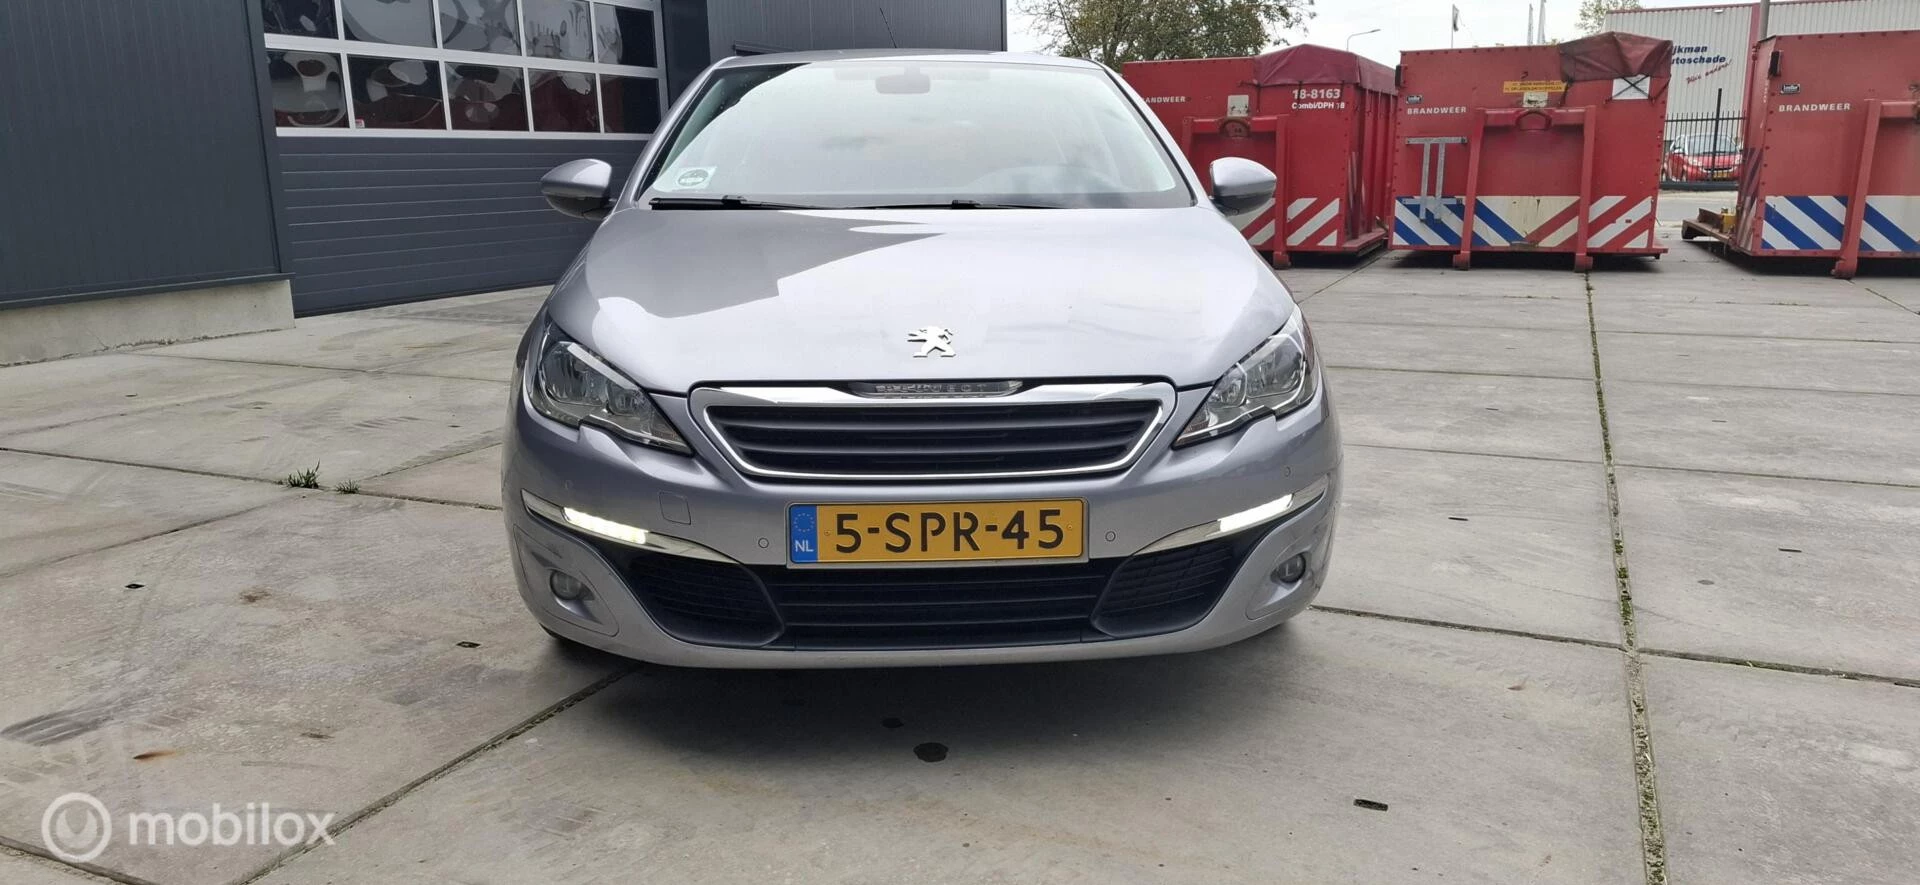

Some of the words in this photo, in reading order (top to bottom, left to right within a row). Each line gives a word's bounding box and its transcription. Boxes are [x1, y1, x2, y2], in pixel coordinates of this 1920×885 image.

[1671, 55, 1726, 65] toschade
[1292, 88, 1341, 99] 18-8163
[1144, 96, 1186, 104] ANDWEER
[1407, 106, 1467, 115] BRANDWEER
[1778, 102, 1851, 112] BRANDWEER
[836, 509, 1064, 554] 5-SPR-45
[794, 540, 814, 553] NL
